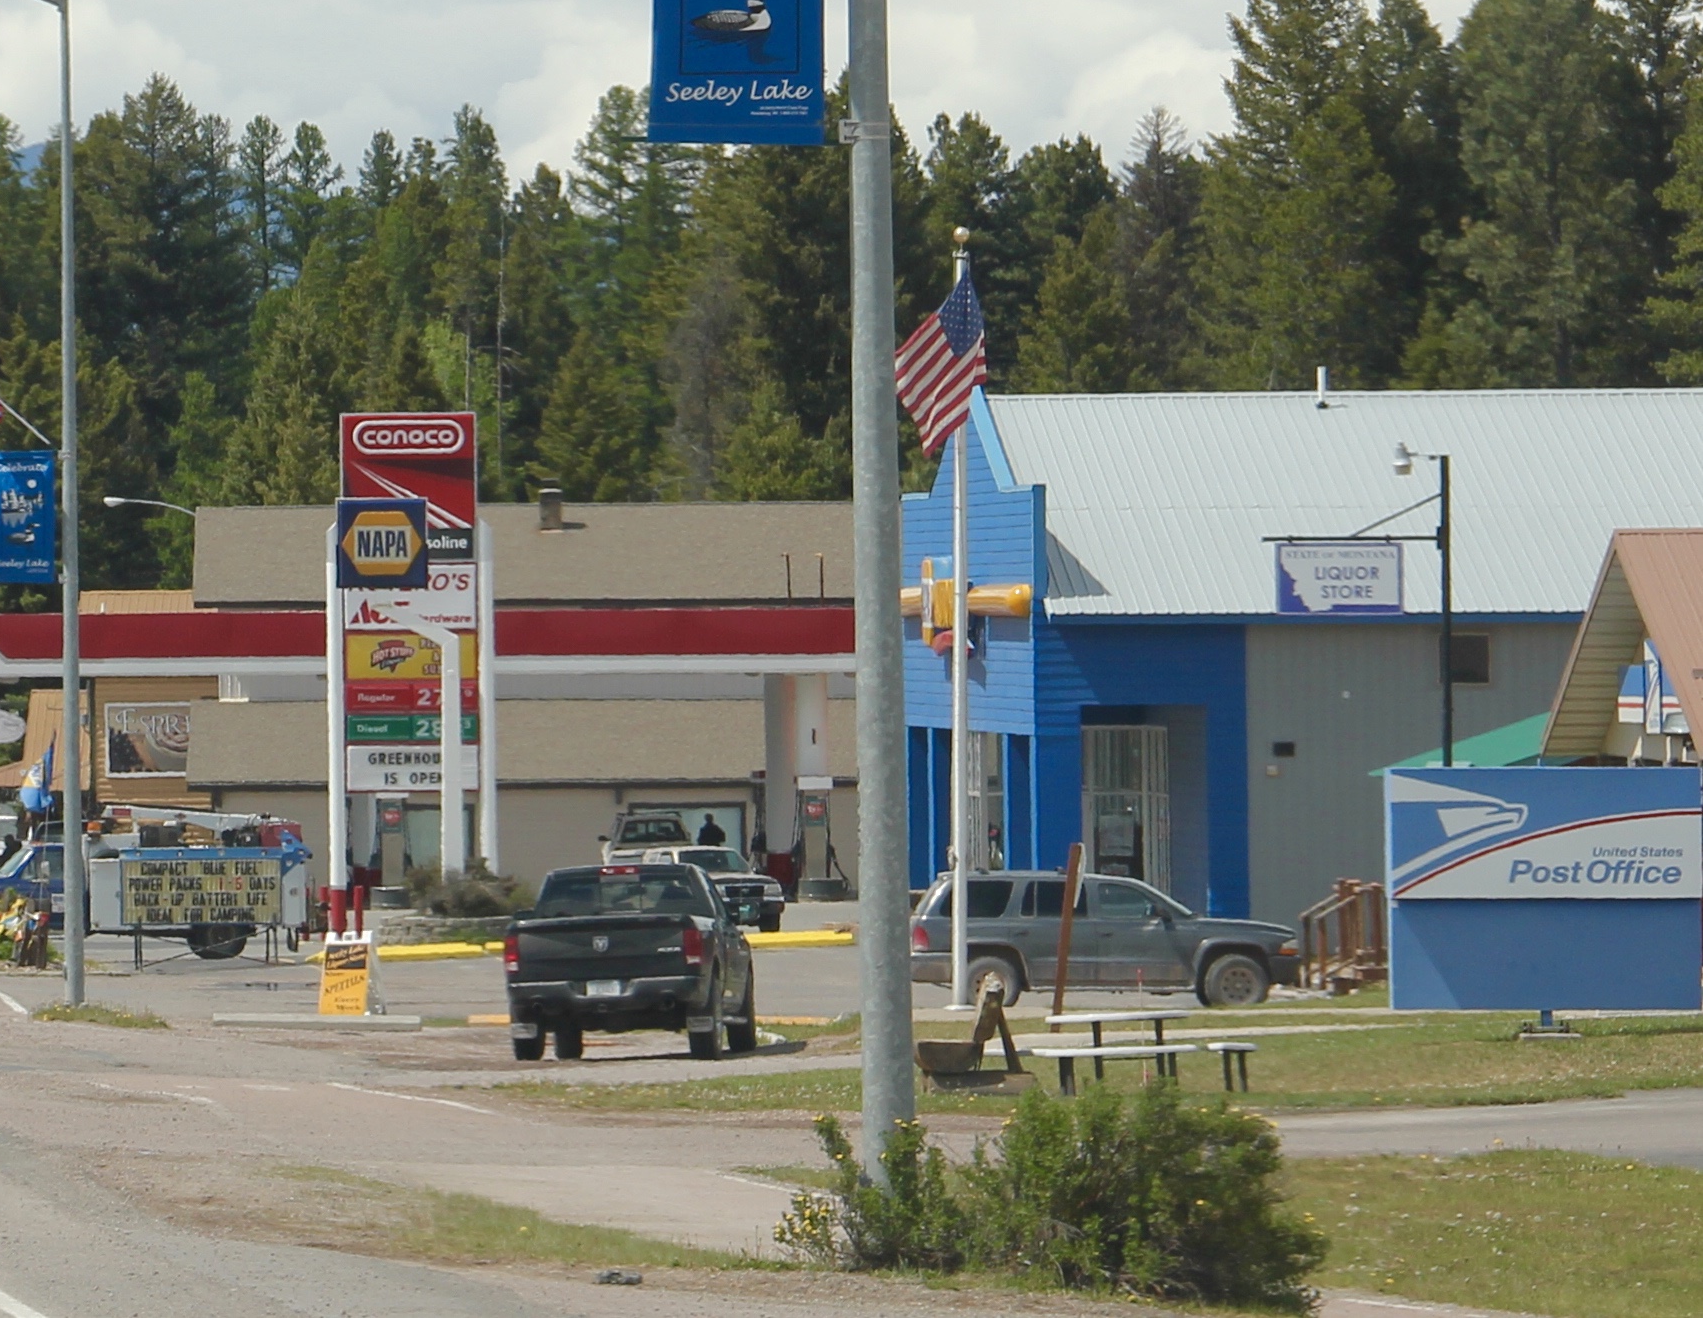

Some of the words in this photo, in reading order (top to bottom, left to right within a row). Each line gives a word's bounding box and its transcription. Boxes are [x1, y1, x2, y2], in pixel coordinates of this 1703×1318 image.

[665, 79, 743, 106] Seeley
[750, 79, 813, 100] Lake
[357, 530, 408, 558] NAPA
[1315, 566, 1380, 581] LIQUOR
[1321, 585, 1373, 599] STORE
[384, 772, 398, 785] IS
[1593, 846, 1637, 858] United
[1640, 845, 1684, 858] States
[1508, 859, 1584, 884] Post
[1586, 859, 1683, 885] Office
[129, 877, 163, 892] POWER
[169, 877, 203, 891] PACKS
[247, 892, 267, 906] LIFE
